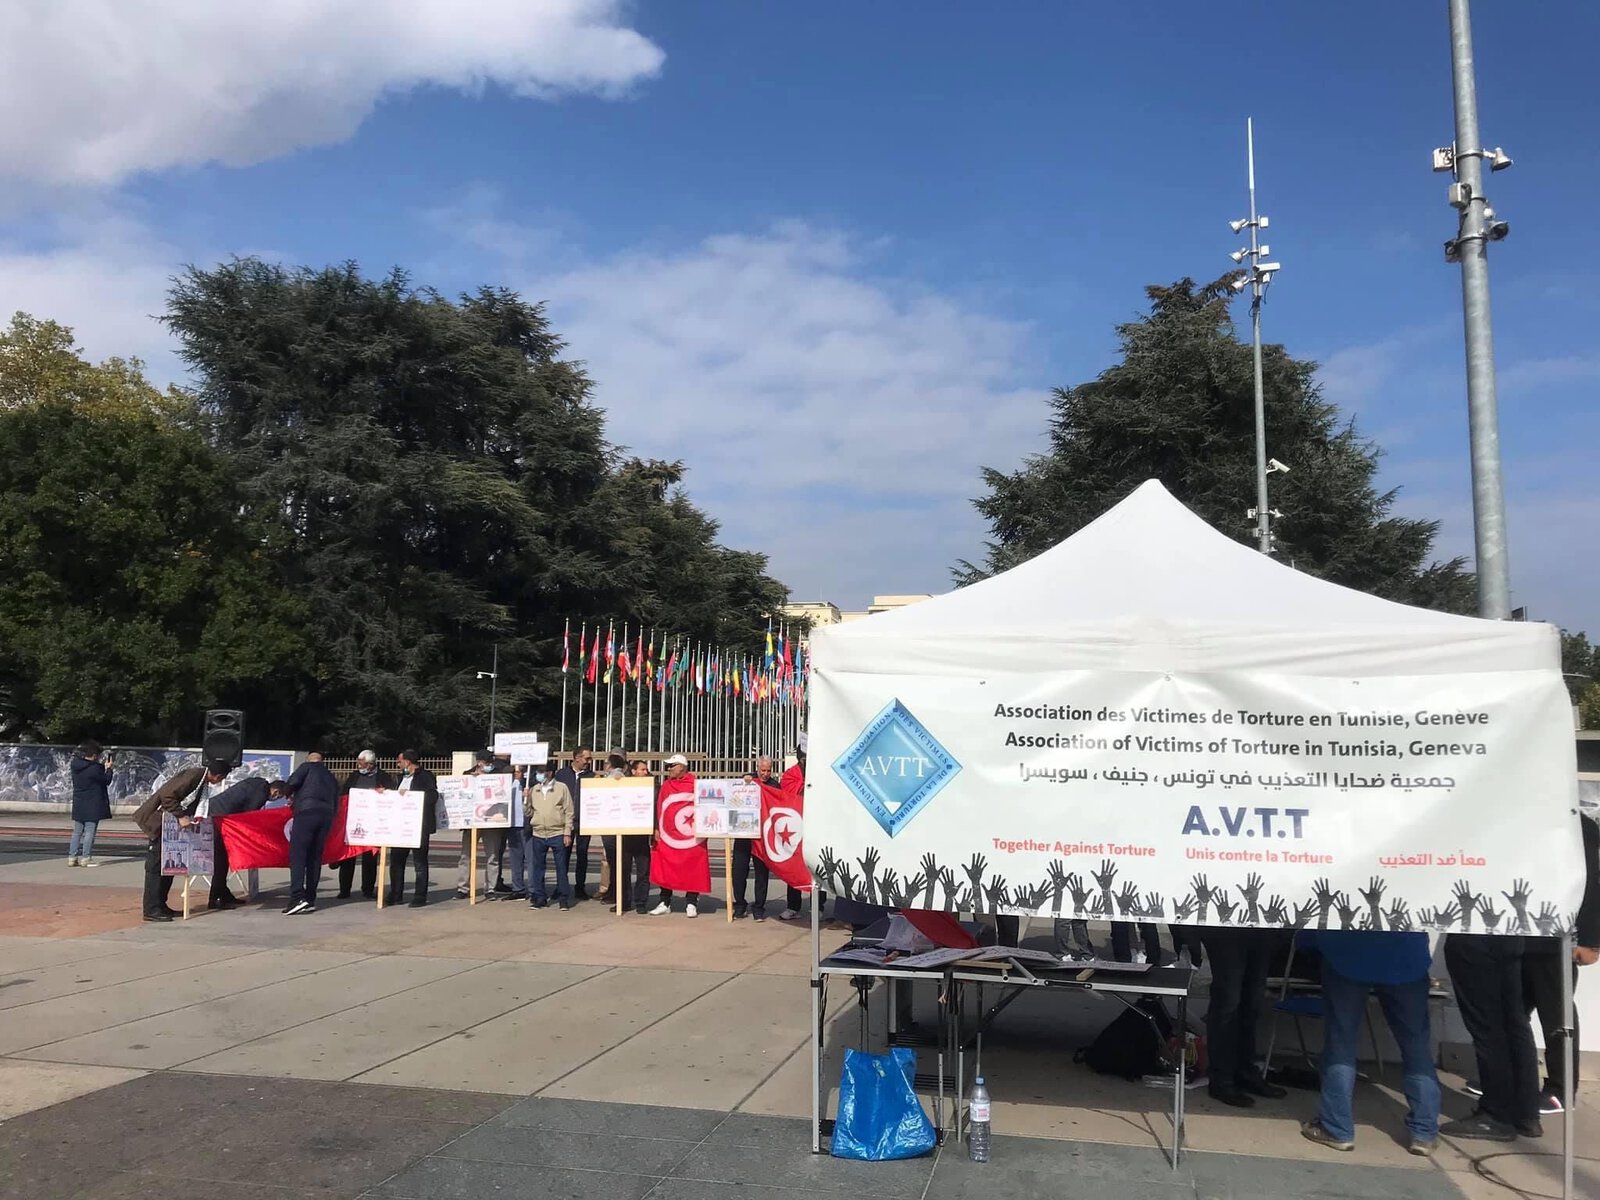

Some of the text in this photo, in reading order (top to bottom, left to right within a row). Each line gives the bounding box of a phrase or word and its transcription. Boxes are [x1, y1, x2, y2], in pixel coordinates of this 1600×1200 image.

[994, 703, 1489, 729] Association des Victimes de Torture en Tunisie, Genève
[847, 713, 891, 762] ASSOCIATION
[898, 712, 949, 765] DES VICTIMES
[1005, 731, 1487, 759] Association of Victims of Torture in Tunisia, Geneva
[859, 756, 929, 777] AVTT
[1020, 763, 1088, 783] سويسرا
[1220, 770, 1253, 789] في
[1258, 771, 1327, 791] التعذيب
[1334, 772, 1385, 792] ضحايا
[1390, 773, 1456, 792] جمعية
[849, 773, 887, 817] EN TUNISIE
[895, 790, 926, 823] TORTURE
[1181, 806, 1309, 838] A.V.T.T
[992, 838, 1156, 857] Together Against Torture
[1186, 847, 1333, 864] Unis contre la Torture
[1379, 854, 1432, 869] التعذيب
[1436, 853, 1456, 866] ضد
